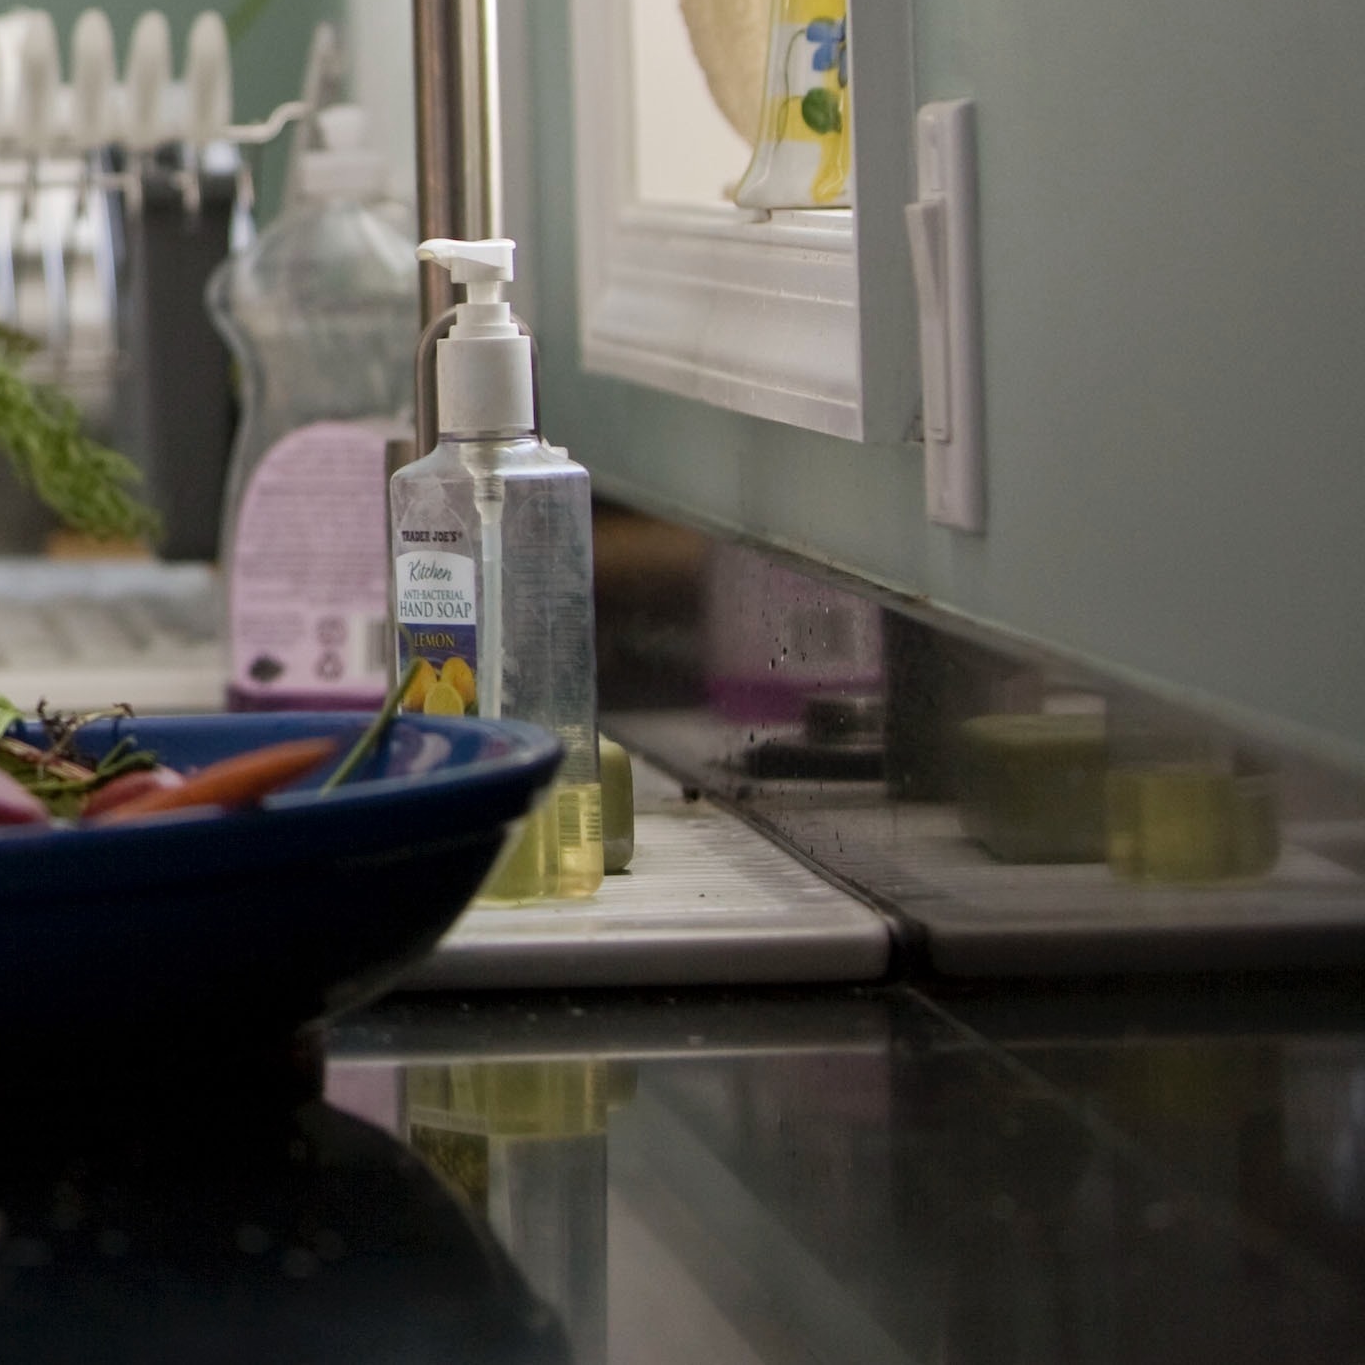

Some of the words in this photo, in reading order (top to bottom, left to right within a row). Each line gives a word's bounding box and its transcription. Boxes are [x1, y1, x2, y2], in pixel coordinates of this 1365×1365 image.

[402, 530, 431, 543] TRADER
[408, 559, 453, 582] Kitchen
[403, 589, 465, 601] ANTI-BACTERIAL
[400, 601, 433, 617] HAND
[437, 601, 472, 619] SOAP
[414, 632, 455, 648] LEMON
